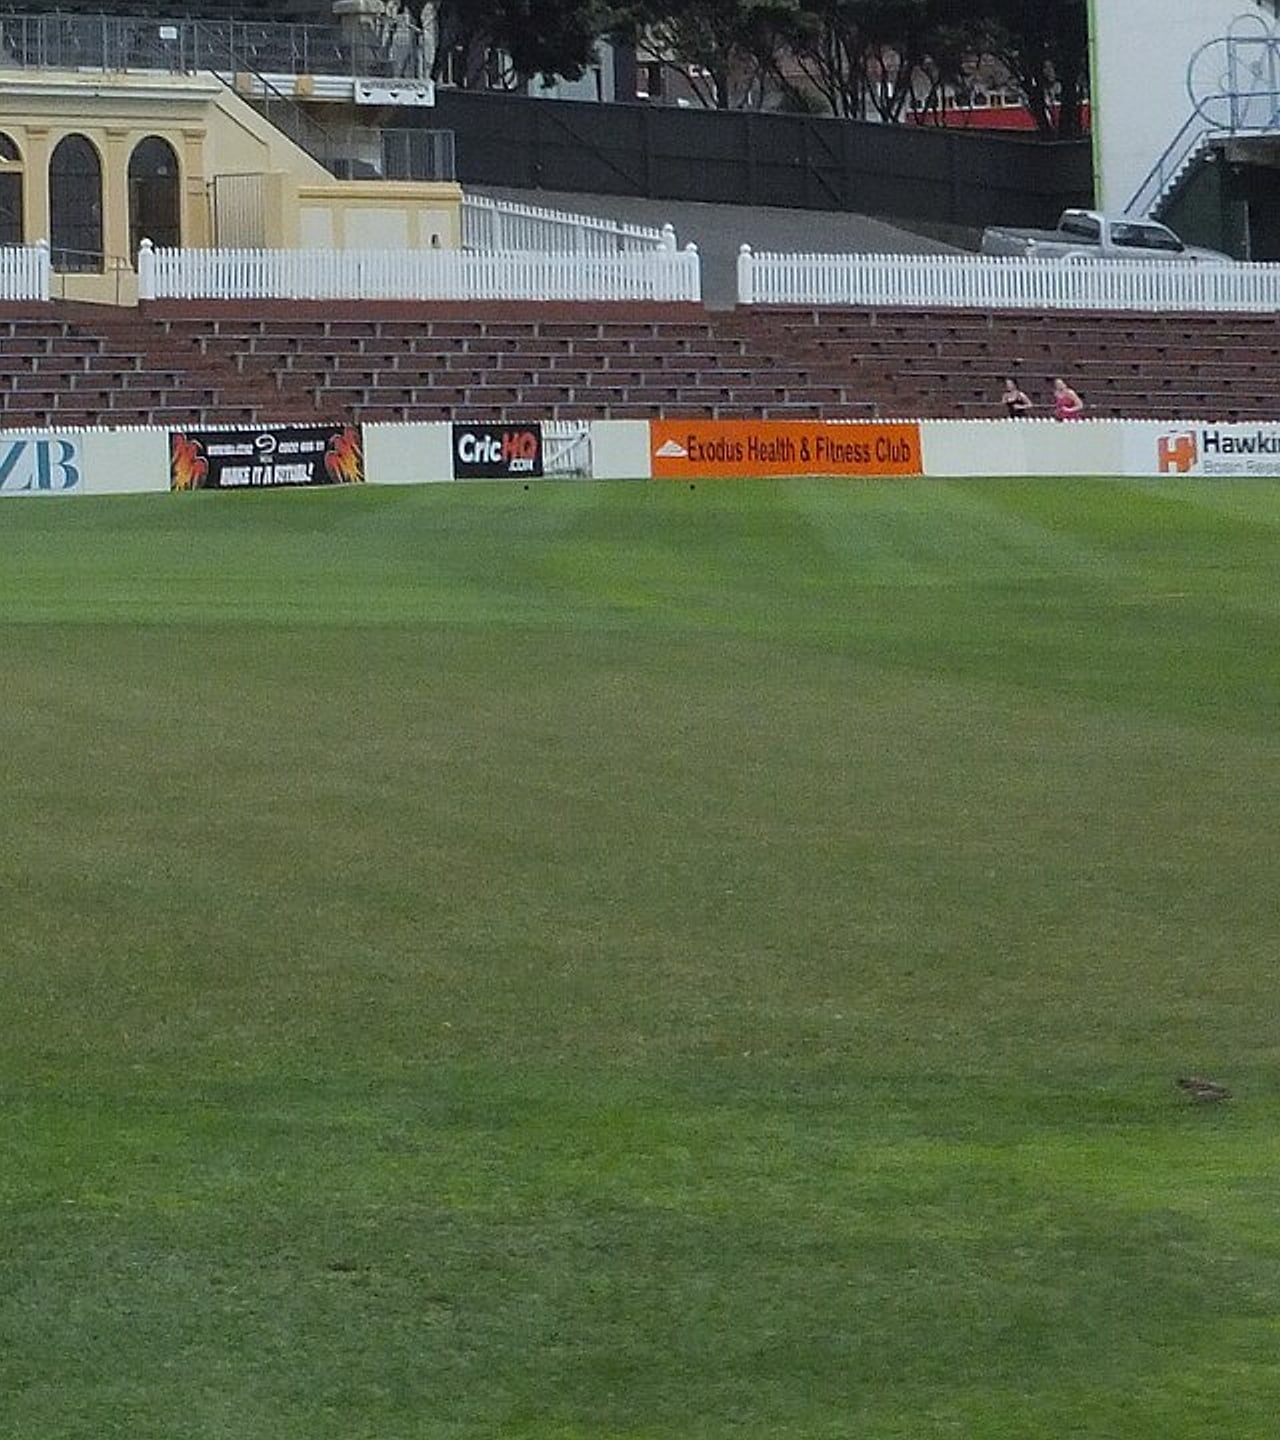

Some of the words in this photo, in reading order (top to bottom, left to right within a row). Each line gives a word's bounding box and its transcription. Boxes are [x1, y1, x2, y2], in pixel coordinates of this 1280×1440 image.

[458, 432, 537, 463] CricHQ
[688, 435, 743, 462] Exodus
[747, 436, 795, 462] Health
[800, 436, 811, 461] &
[816, 436, 871, 464] Fitness
[875, 436, 911, 464] Club
[1202, 430, 1280, 453] Hawki
